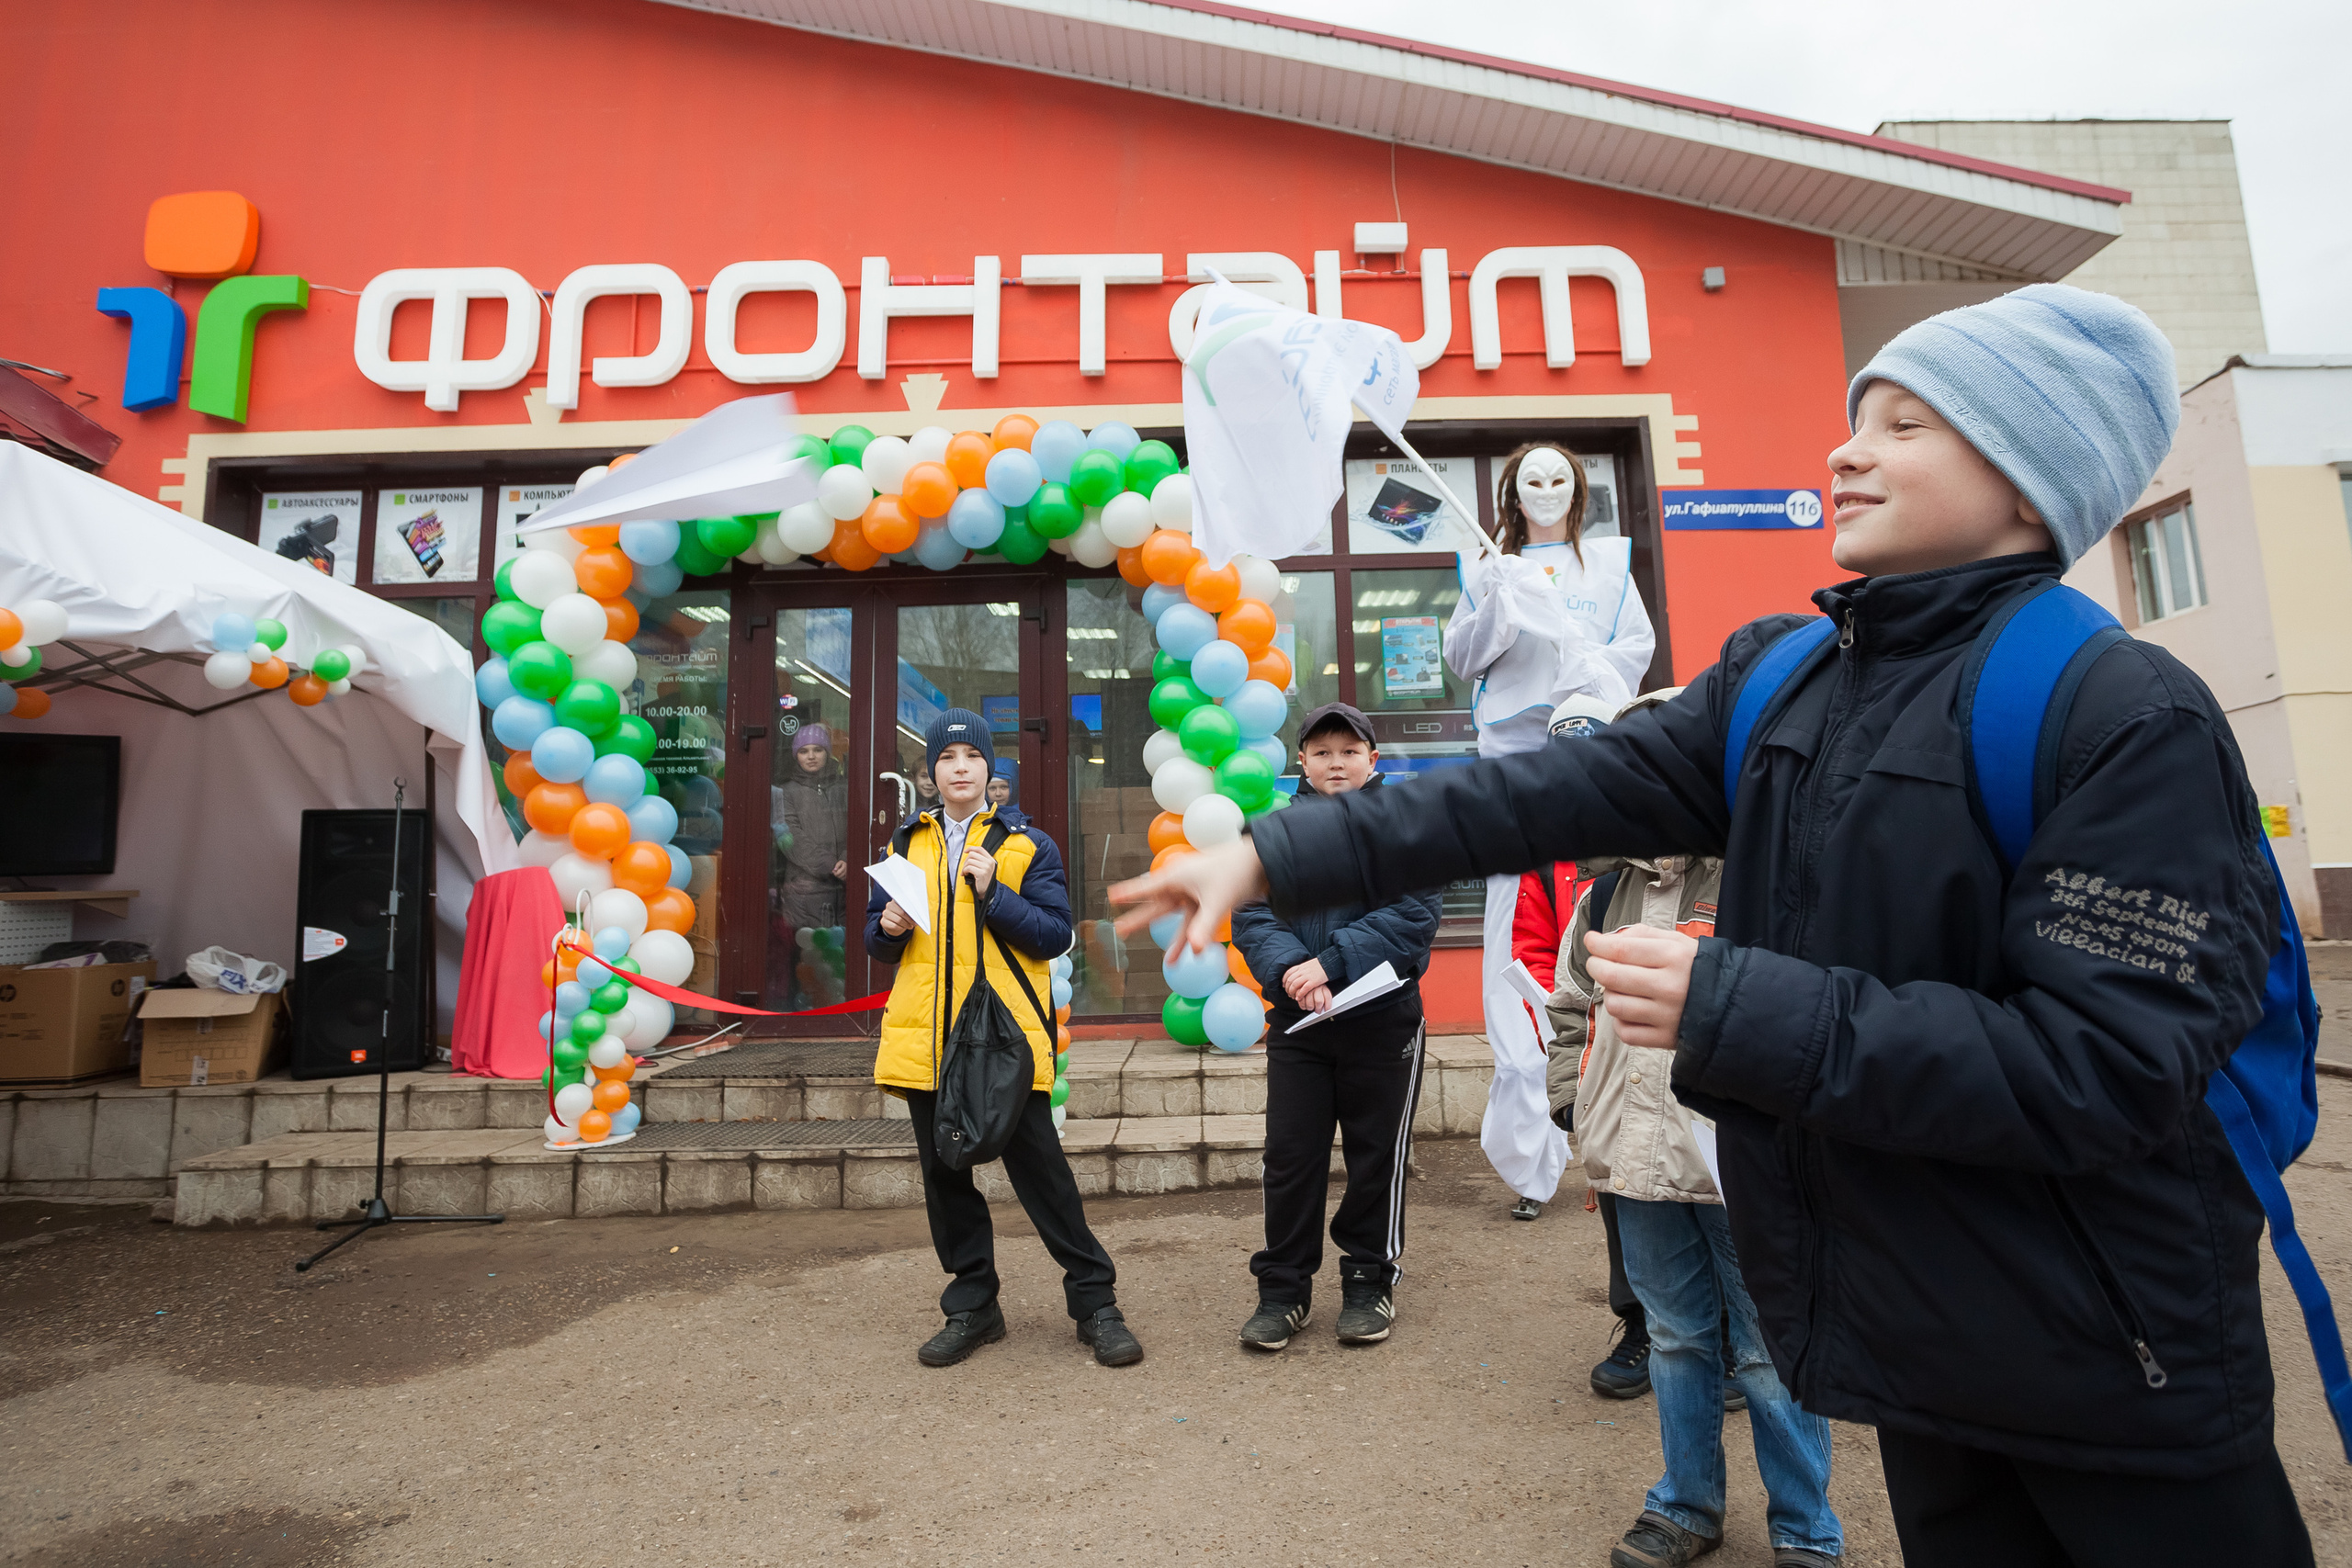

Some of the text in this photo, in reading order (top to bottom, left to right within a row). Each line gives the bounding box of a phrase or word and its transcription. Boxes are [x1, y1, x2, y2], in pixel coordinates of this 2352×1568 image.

[1390, 462, 1448, 473] ПЛАНТЫ
[409, 492, 469, 504] СМАРТФОНЫ
[523, 489, 575, 501] КОМПЬЮТ
[281, 497, 359, 508] АВТОАКСЕССУАРЫ
[645, 705, 707, 717] 10.00-20.00
[1402, 722, 1443, 734] LED
[656, 738, 707, 750] .00-19.00
[666, 765, 698, 774] 36-92-95
[2158, 894, 2211, 931] Rich
[2091, 899, 2200, 942] September
